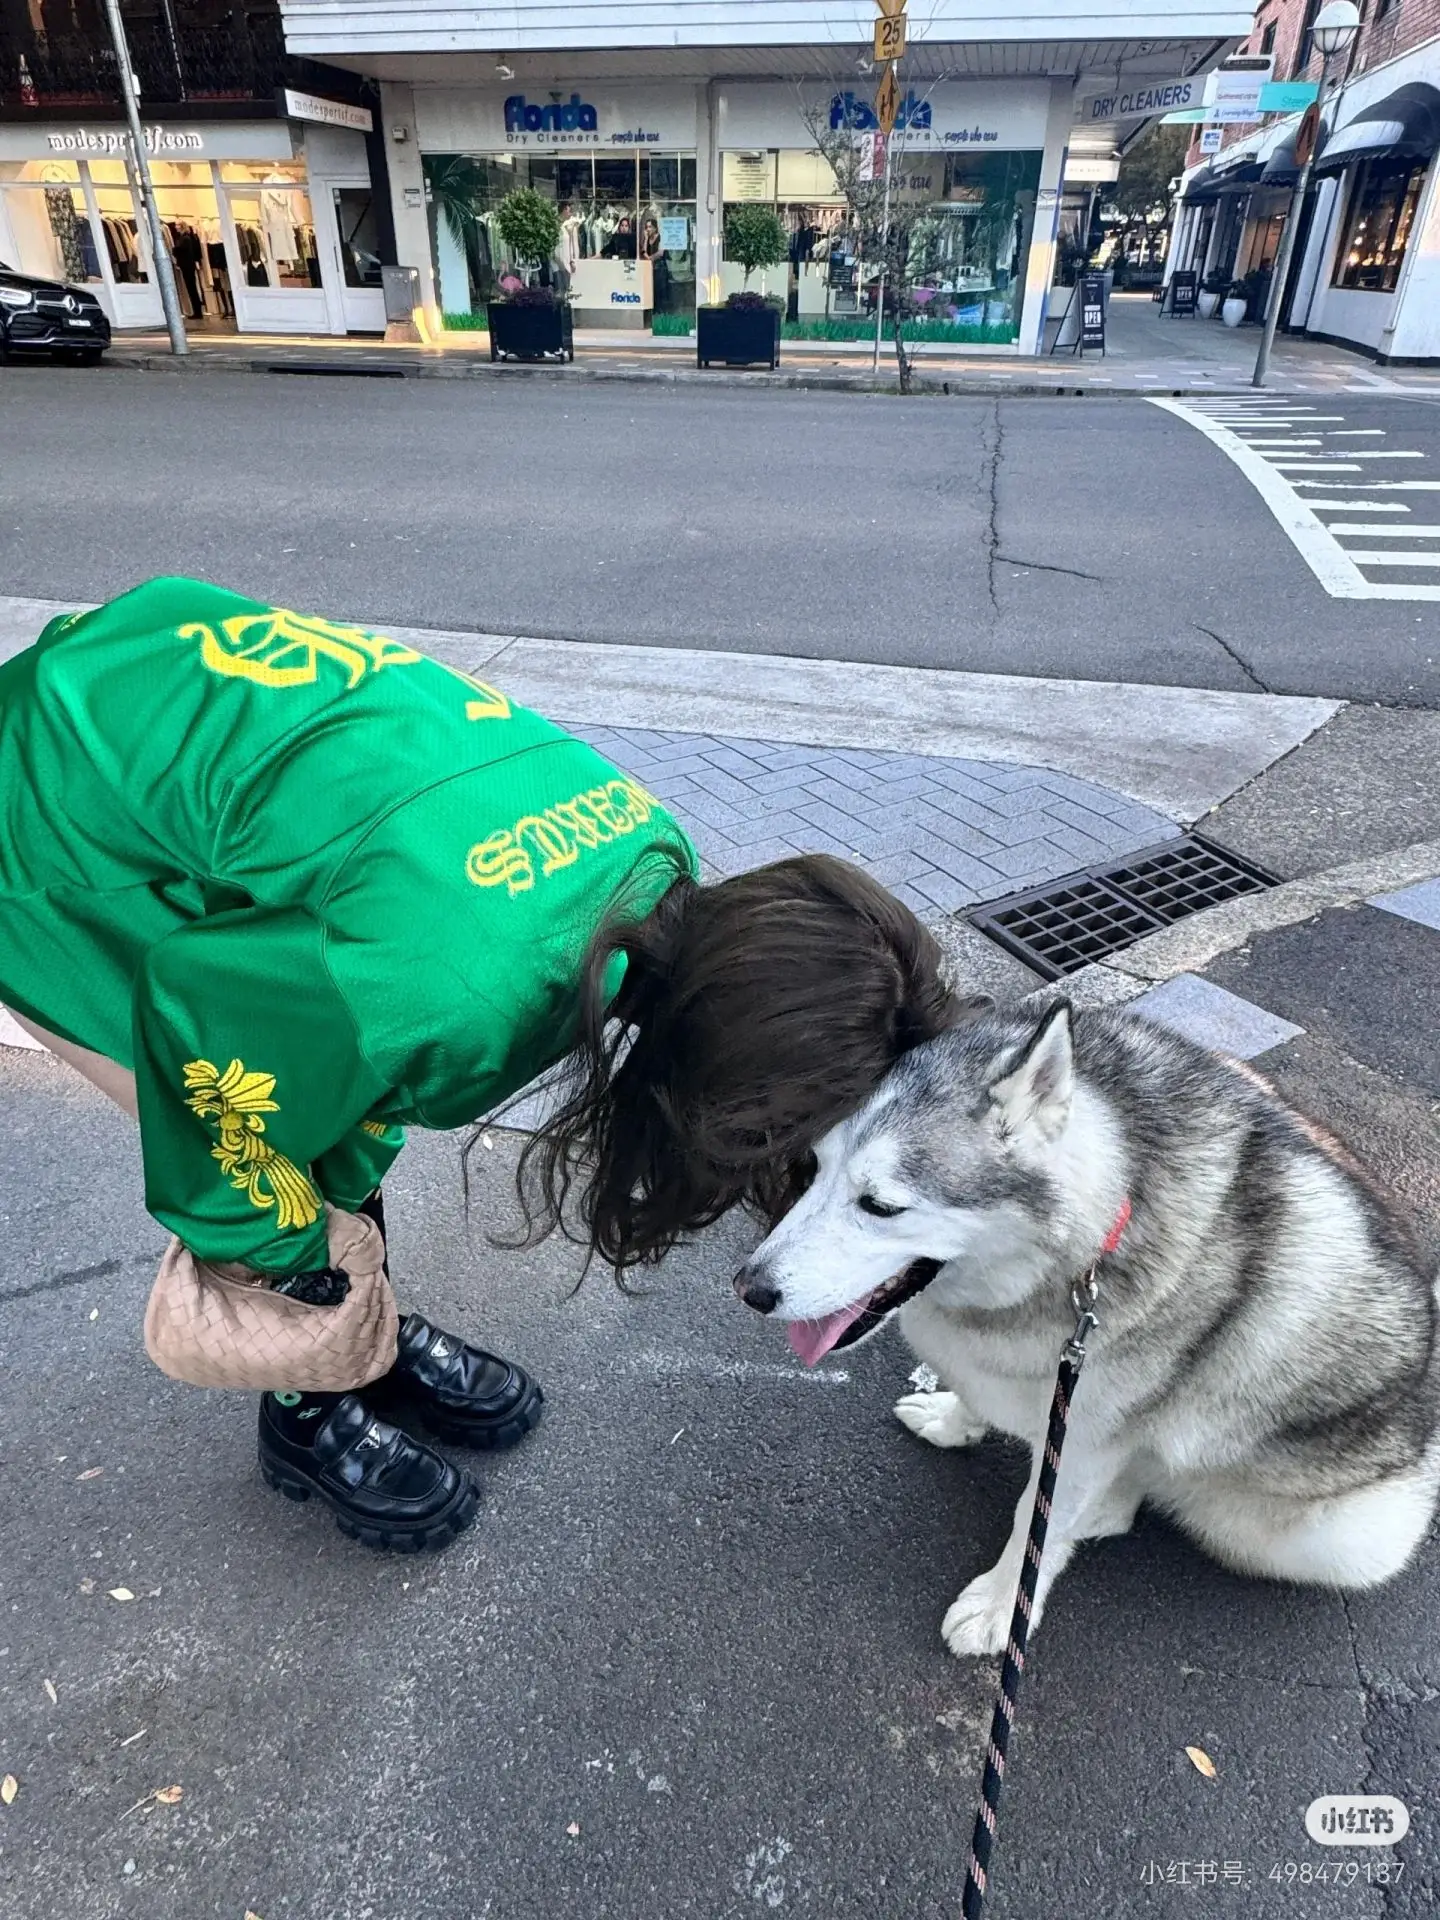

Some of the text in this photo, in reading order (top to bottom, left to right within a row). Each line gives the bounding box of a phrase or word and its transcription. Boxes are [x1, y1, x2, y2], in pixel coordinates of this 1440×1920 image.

[882, 19, 900, 46] 25
[1092, 83, 1192, 119] DRY CLEANERS
[504, 92, 598, 132] florida
[506, 133, 528, 145] Dry
[537, 133, 599, 143] Cleaners
[611, 291, 641, 304] florida
[1176, 290, 1193, 300] OPEN
[1084, 311, 1102, 324] OPEN
